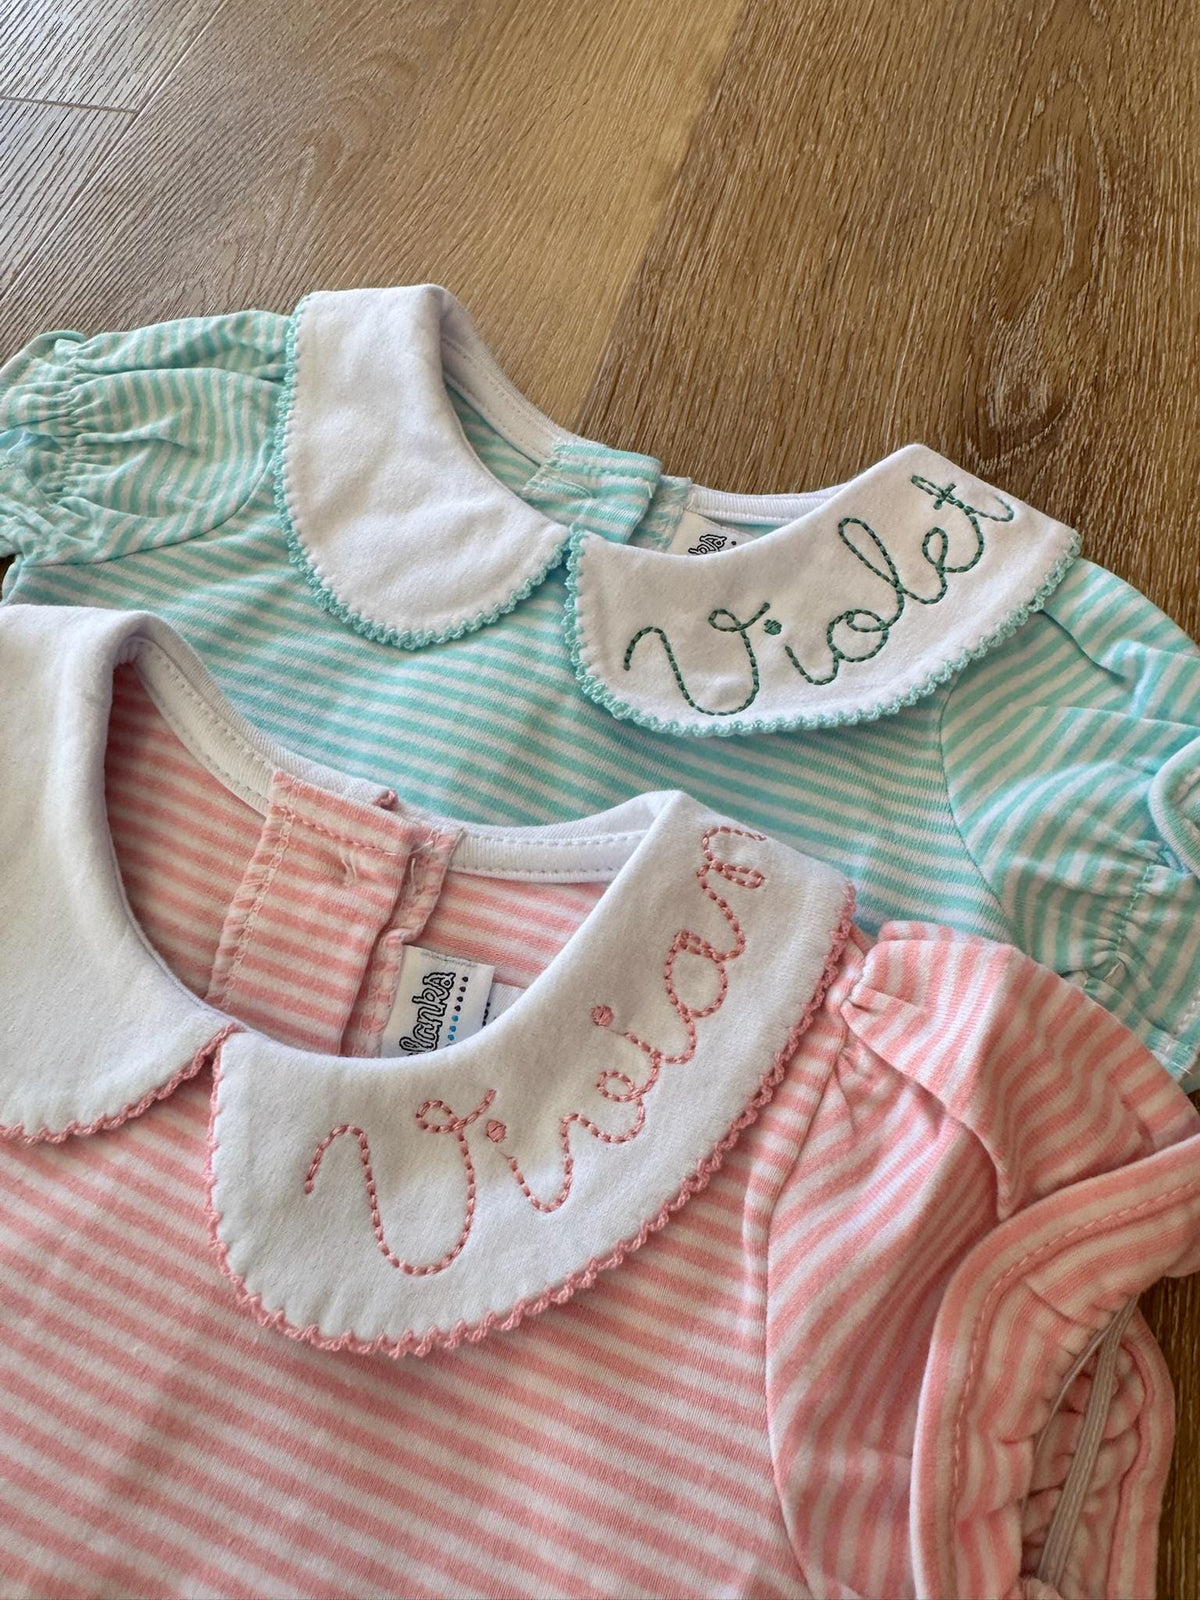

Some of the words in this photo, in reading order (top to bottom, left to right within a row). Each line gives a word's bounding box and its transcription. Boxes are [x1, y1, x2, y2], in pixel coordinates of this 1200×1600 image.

[623, 474, 1014, 716] Violet
[303, 825, 766, 1276] Vivian
[399, 971, 457, 1054] lanks
